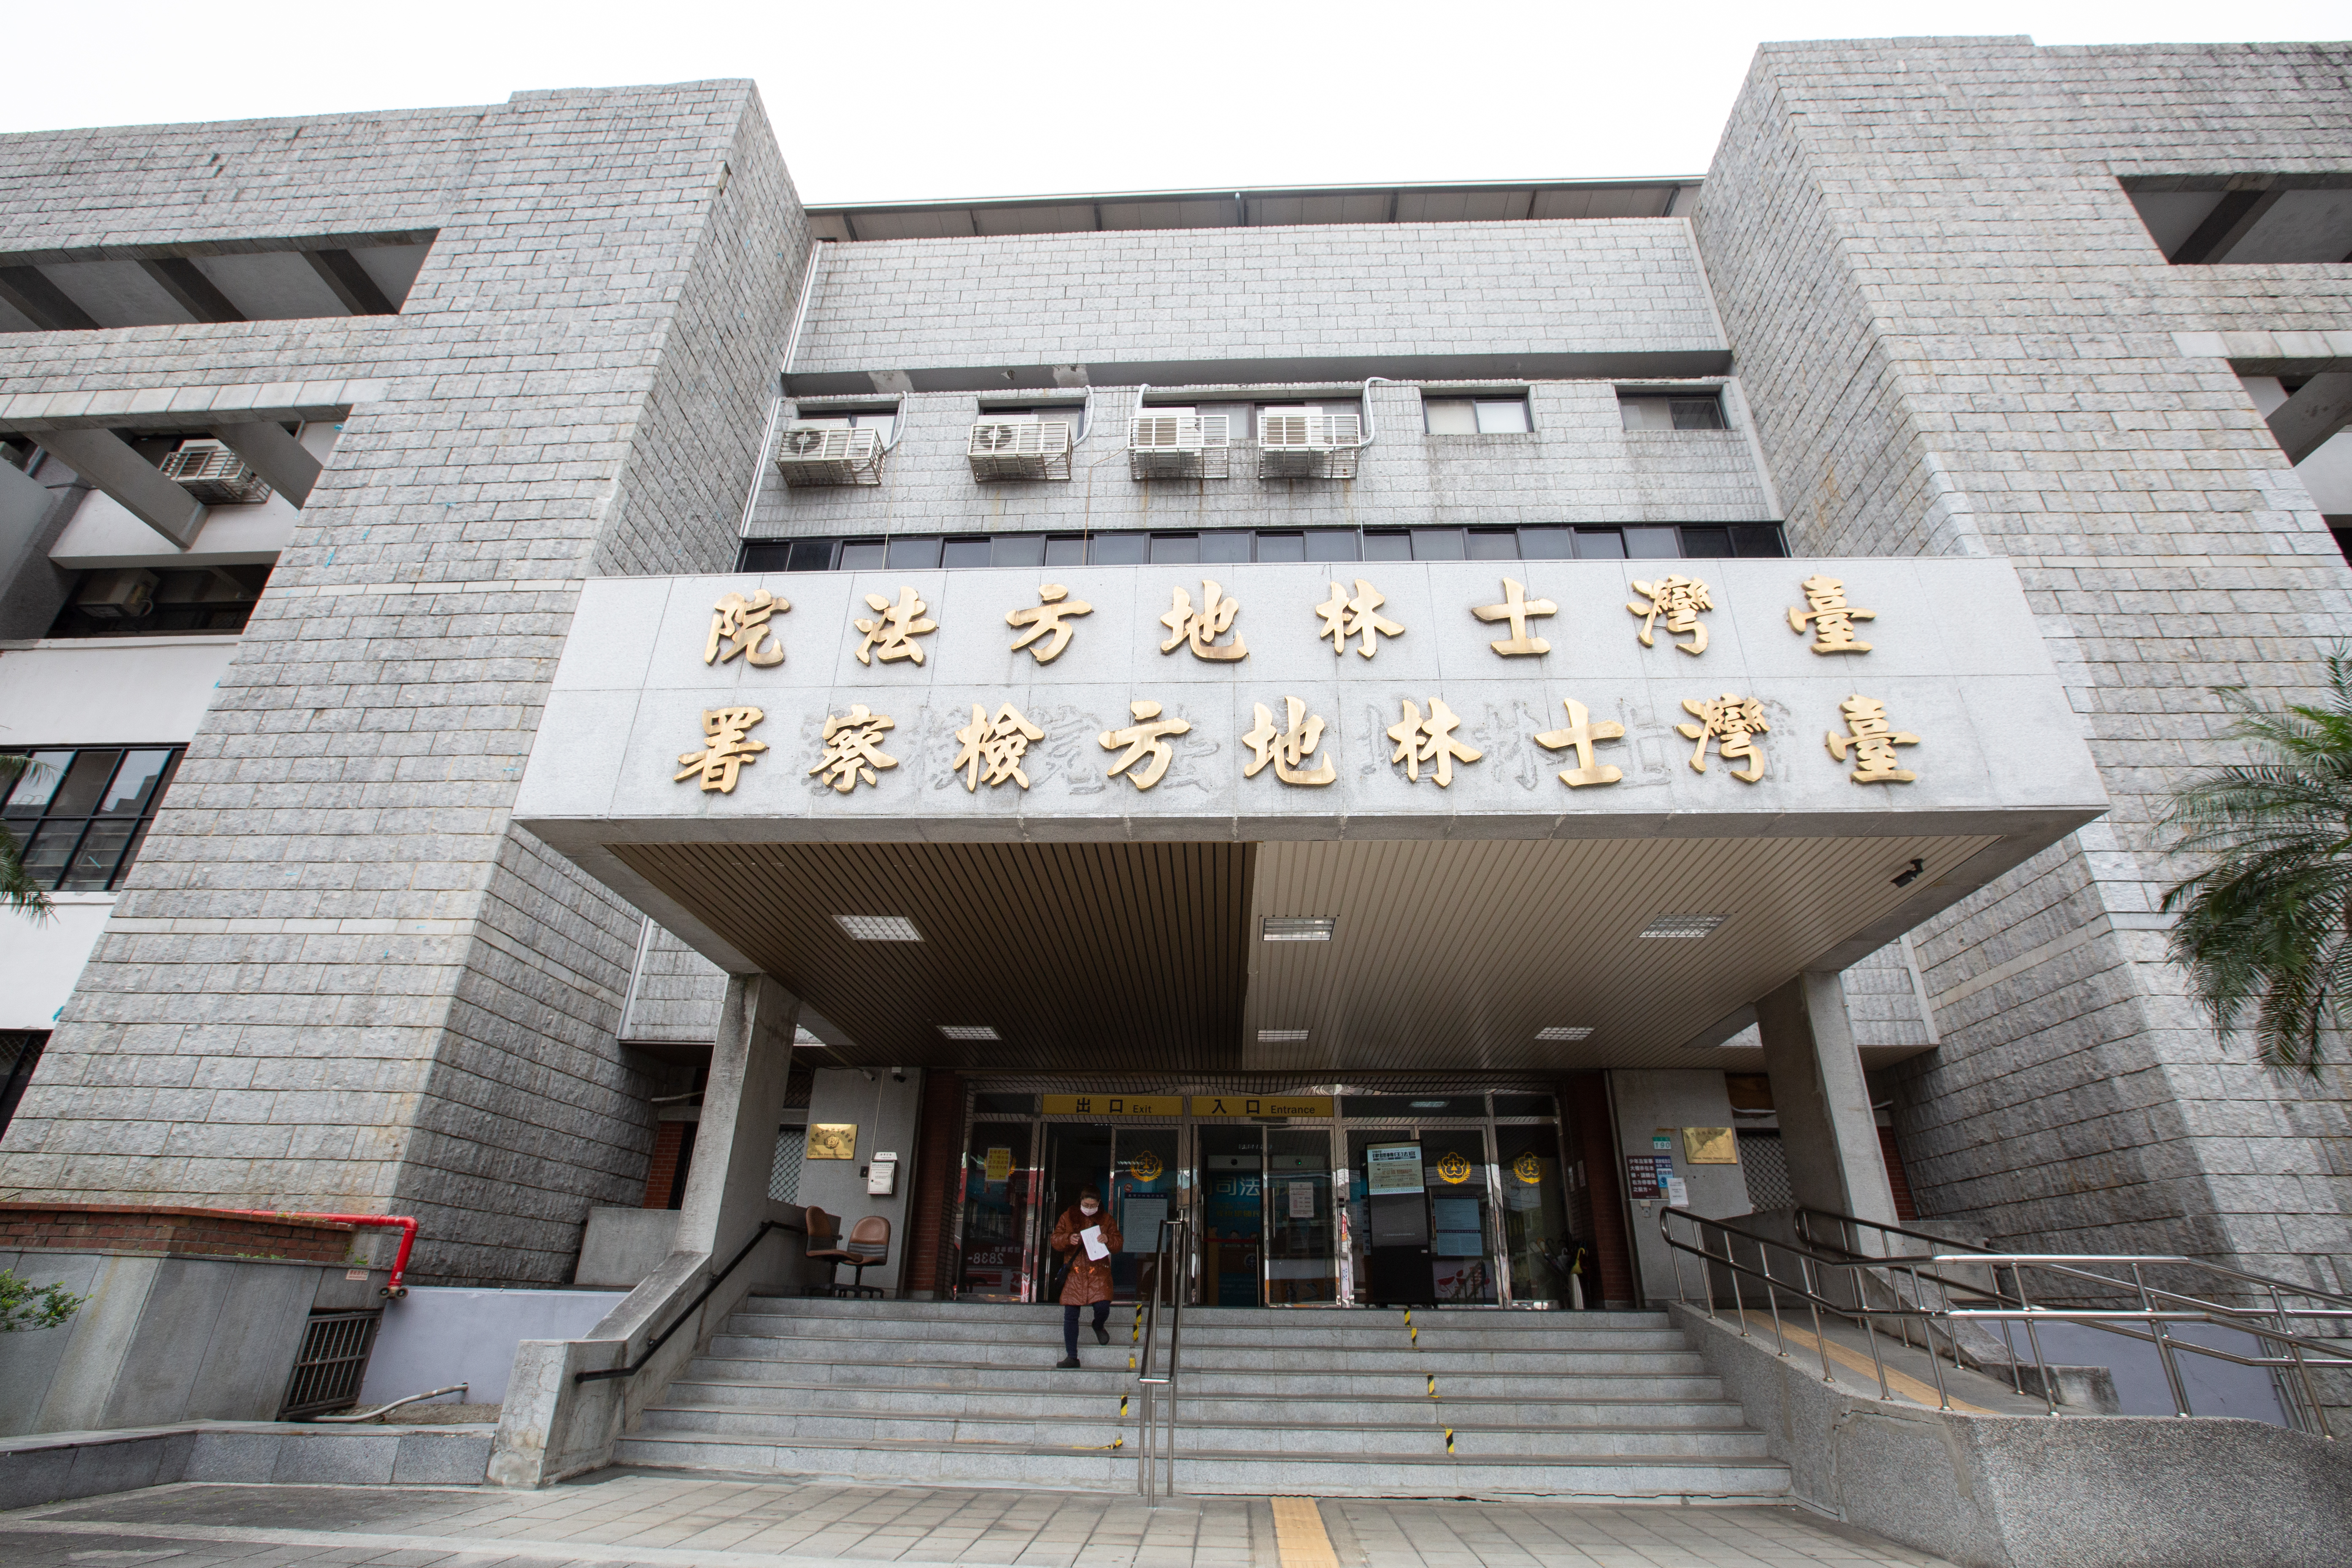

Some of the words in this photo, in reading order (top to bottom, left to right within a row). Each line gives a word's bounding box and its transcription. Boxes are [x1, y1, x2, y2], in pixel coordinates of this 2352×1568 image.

[1076, 1098, 1123, 1114] 出口
[1133, 1104, 1152, 1114] Exit
[1212, 1099, 1260, 1115] 入口
[1271, 1105, 1315, 1114] Entrance
